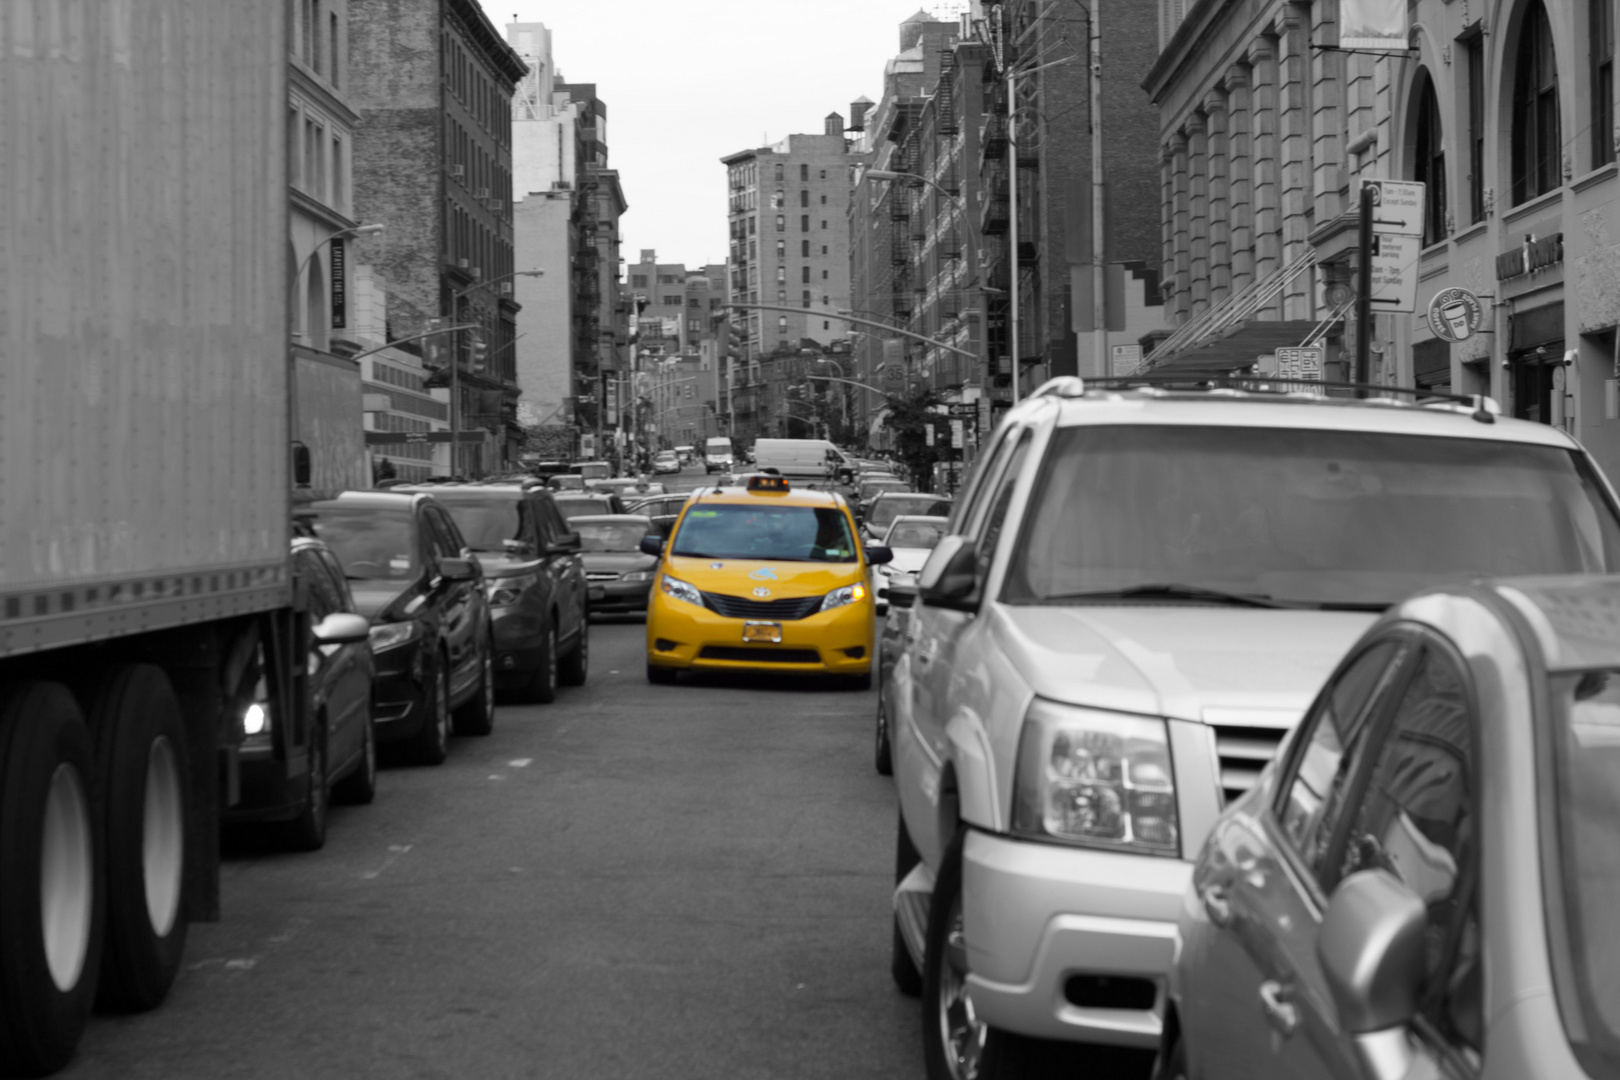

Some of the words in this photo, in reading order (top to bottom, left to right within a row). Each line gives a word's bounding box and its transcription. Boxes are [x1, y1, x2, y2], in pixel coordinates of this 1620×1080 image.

[332, 246, 343, 280] LAFAYETTE
[1433, 307, 1446, 333] COFFEE
[888, 368, 904, 381] 35
